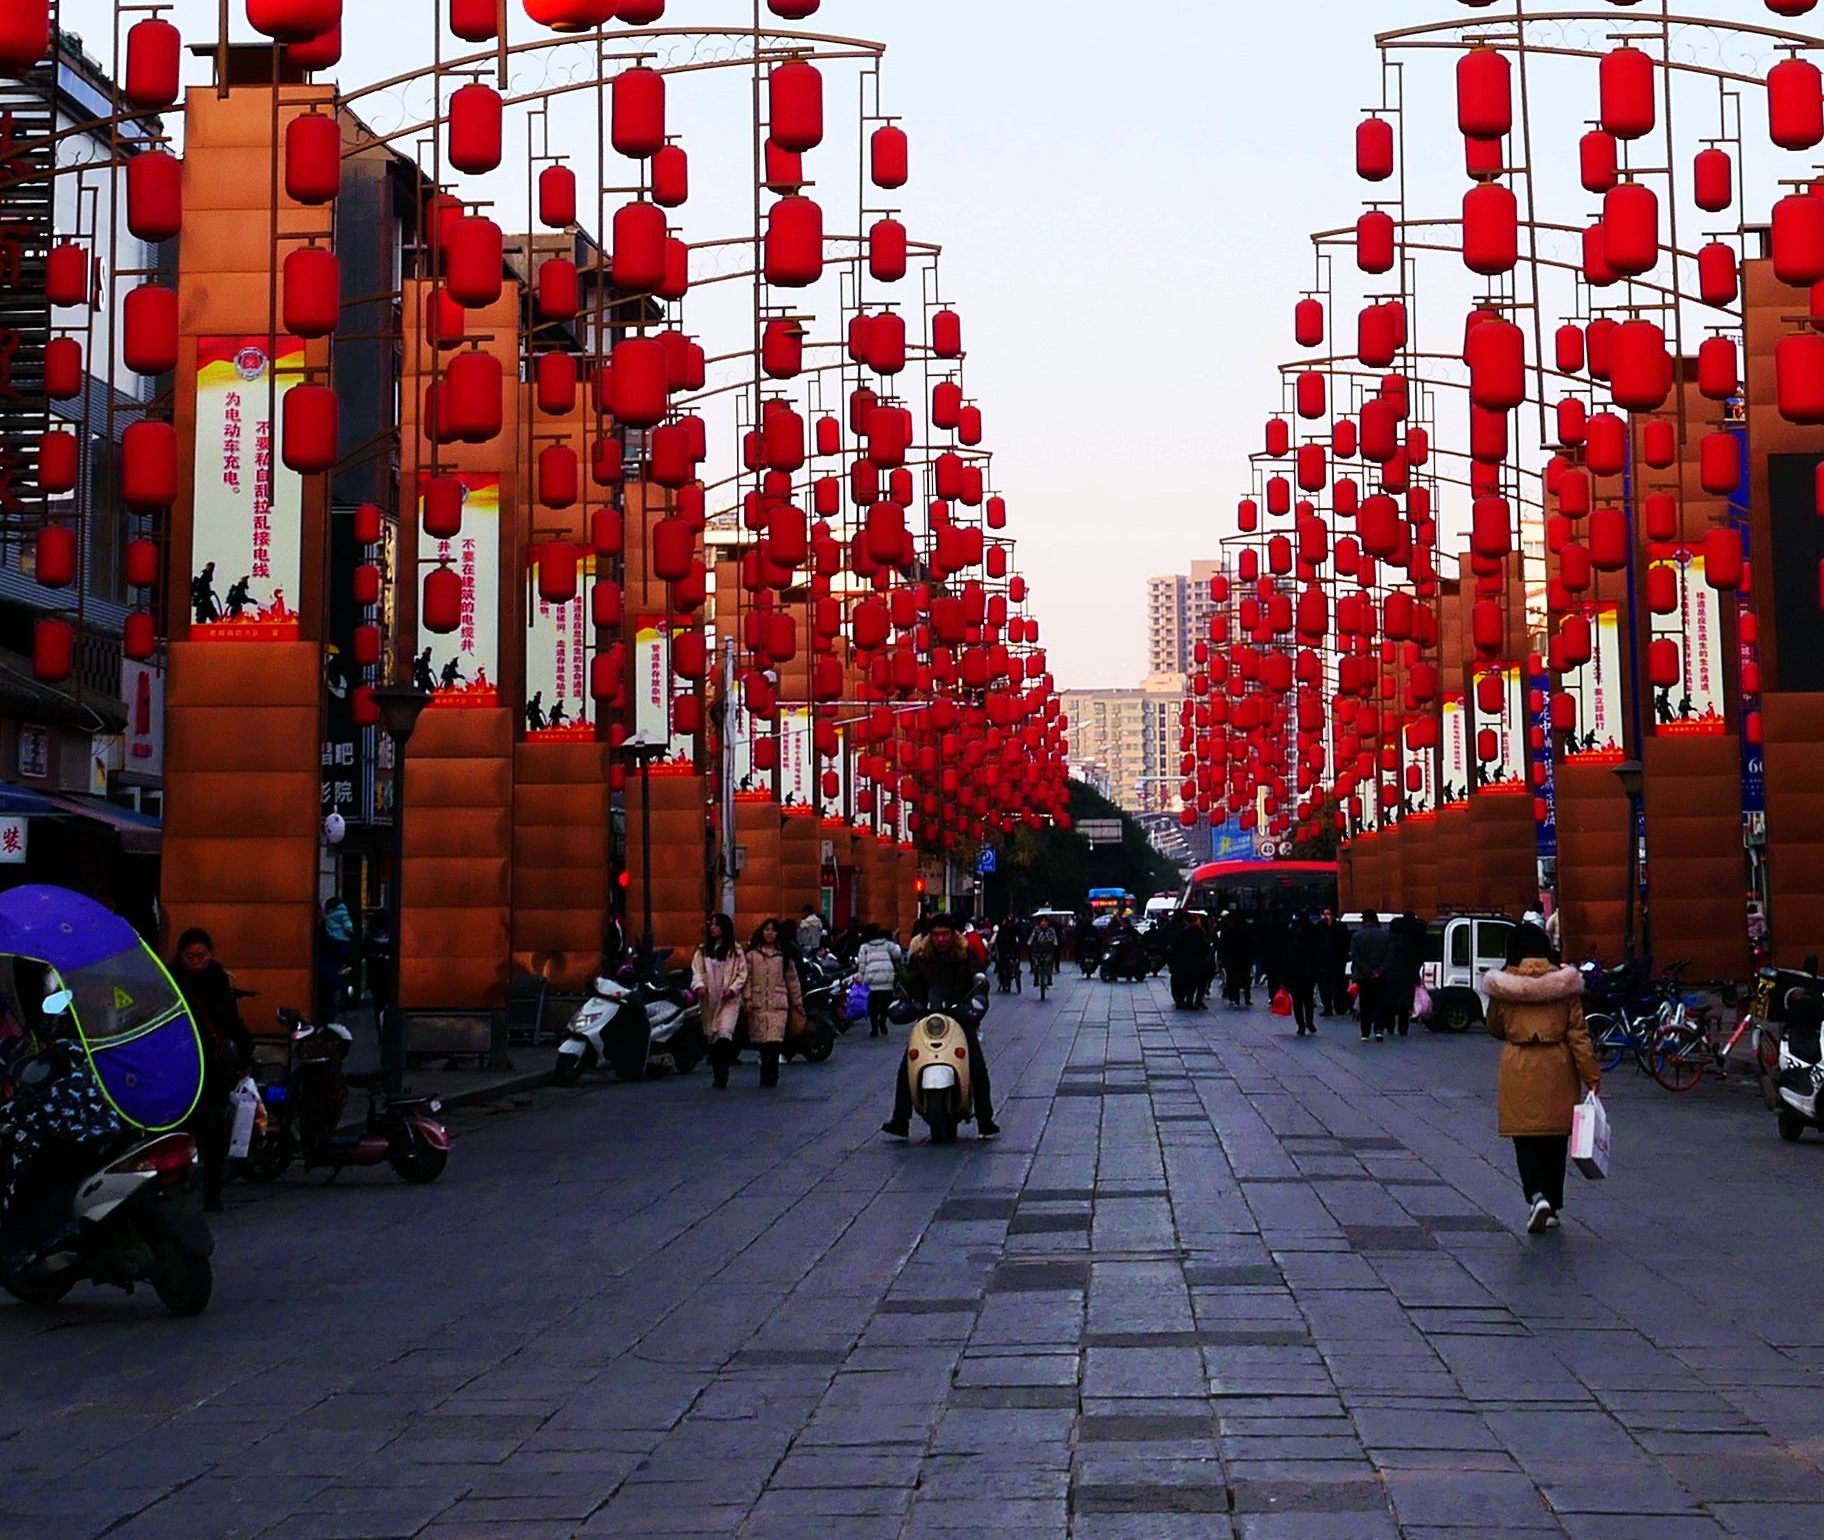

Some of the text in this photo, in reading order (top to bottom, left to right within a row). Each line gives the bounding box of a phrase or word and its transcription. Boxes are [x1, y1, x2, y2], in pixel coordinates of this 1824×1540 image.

[223, 392, 241, 494] 为电动车充电。
